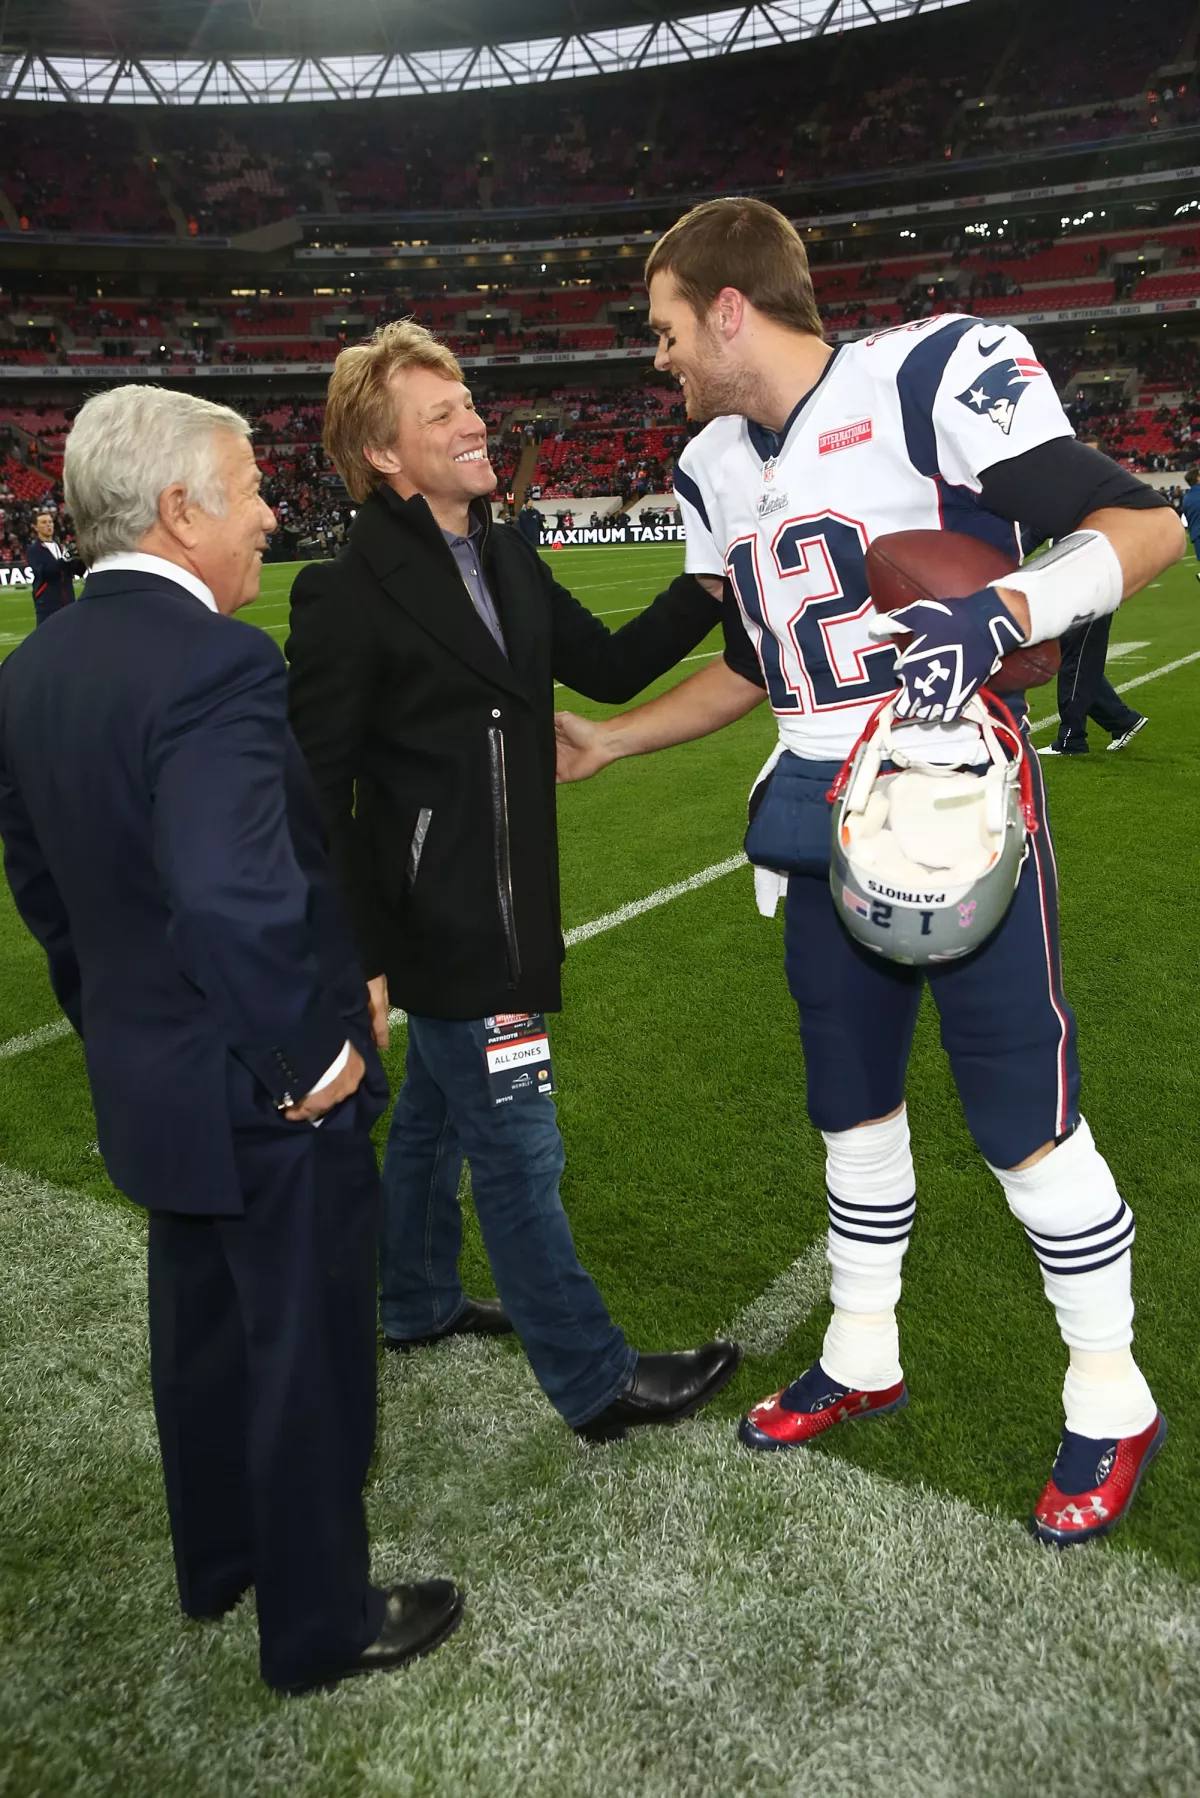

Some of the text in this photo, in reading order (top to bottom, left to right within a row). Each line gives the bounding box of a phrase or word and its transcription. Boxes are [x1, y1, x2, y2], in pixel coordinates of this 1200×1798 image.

[1176, 169, 1195, 178] VISA
[1028, 315, 1045, 323] VISA
[1071, 307, 1118, 319] INTERNATIONAL
[820, 422, 871, 447] INTERNATIONAL
[540, 525, 686, 545] MAXIMUM TASTE
[0, 566, 35, 586] TAS
[724, 508, 903, 715] 12
[868, 879, 945, 904] PATRIOTS
[488, 1032, 518, 1044] PATRIOTS
[495, 1046, 542, 1065] ALL ZONES
